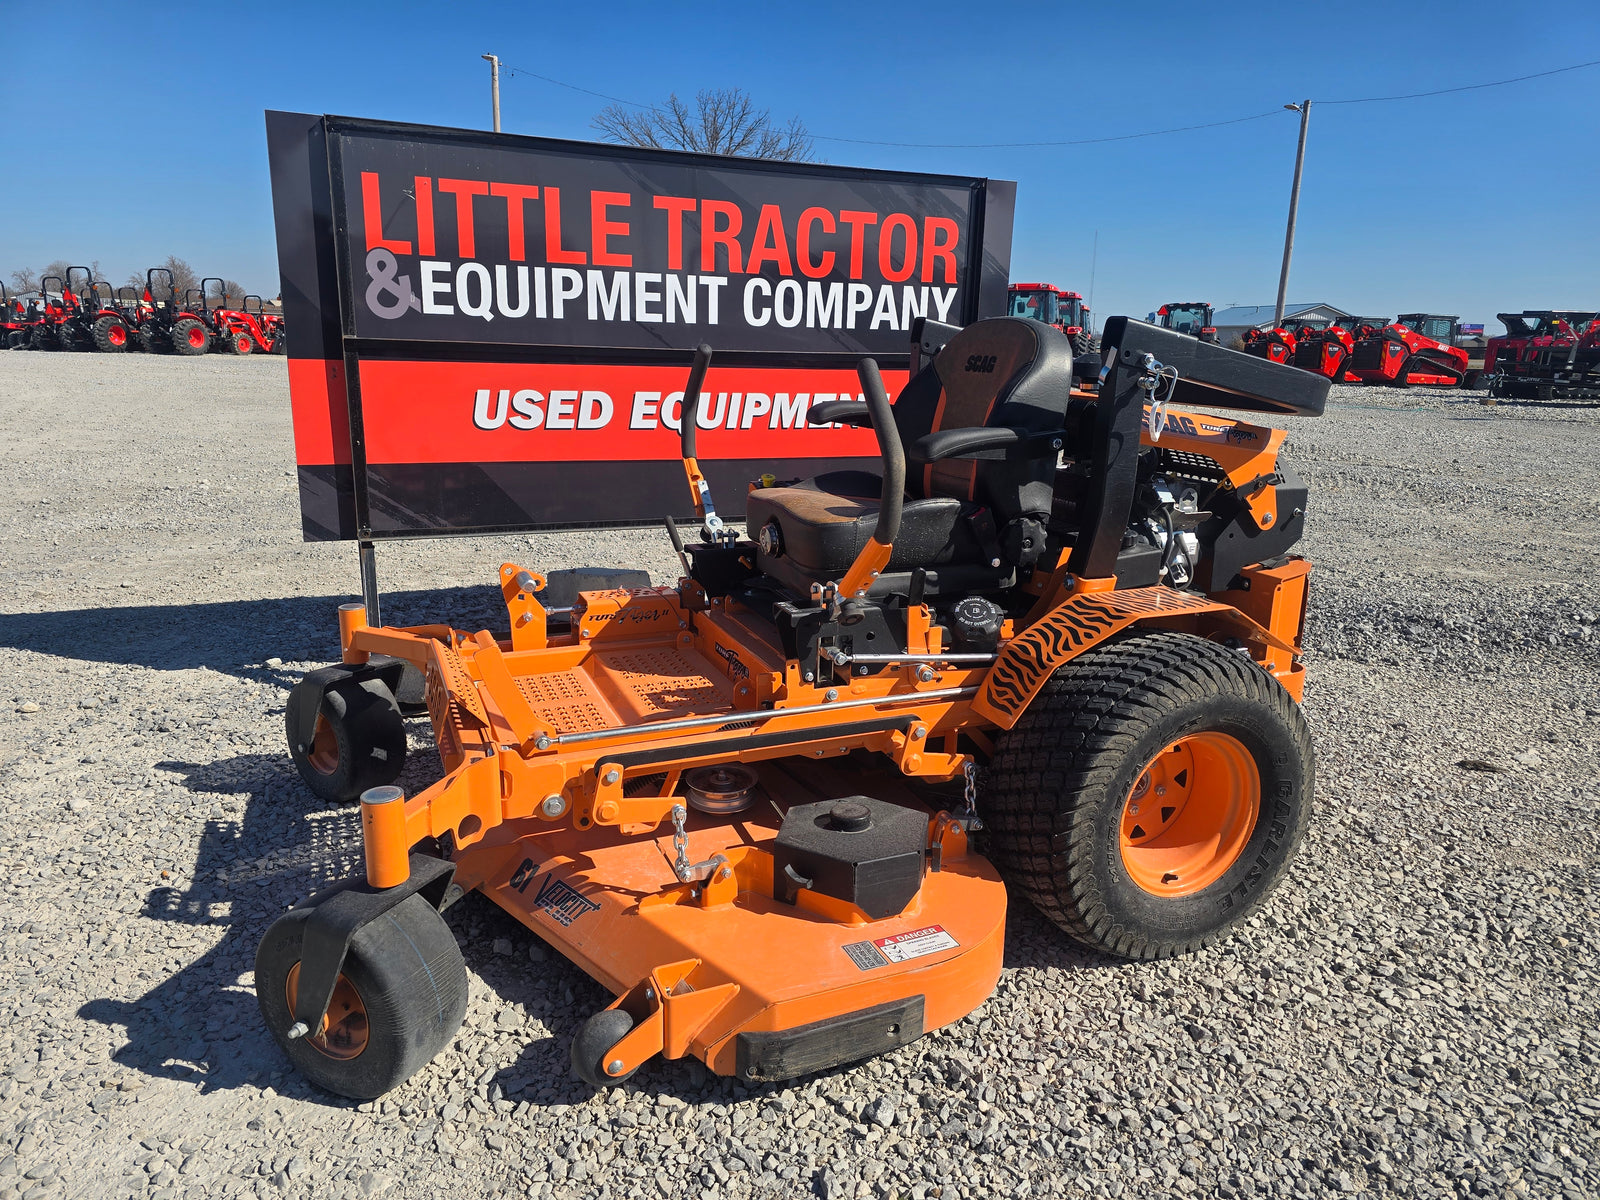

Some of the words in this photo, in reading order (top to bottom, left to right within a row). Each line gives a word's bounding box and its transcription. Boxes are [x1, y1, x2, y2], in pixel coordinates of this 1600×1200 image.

[361, 171, 632, 267] LITTLE
[653, 195, 960, 284] TRACTOR
[366, 248, 422, 320] &
[420, 260, 728, 324] EQUIPMENT
[743, 278, 957, 331] COMPANY
[965, 355, 997, 373] SCAG
[474, 389, 614, 430] USED
[613, 605, 661, 624] Tiger
[1216, 780, 1293, 915] CARLISLE
[510, 857, 540, 893] 61
[534, 873, 601, 920] VELOCITY
[896, 927, 938, 942] DANGER
